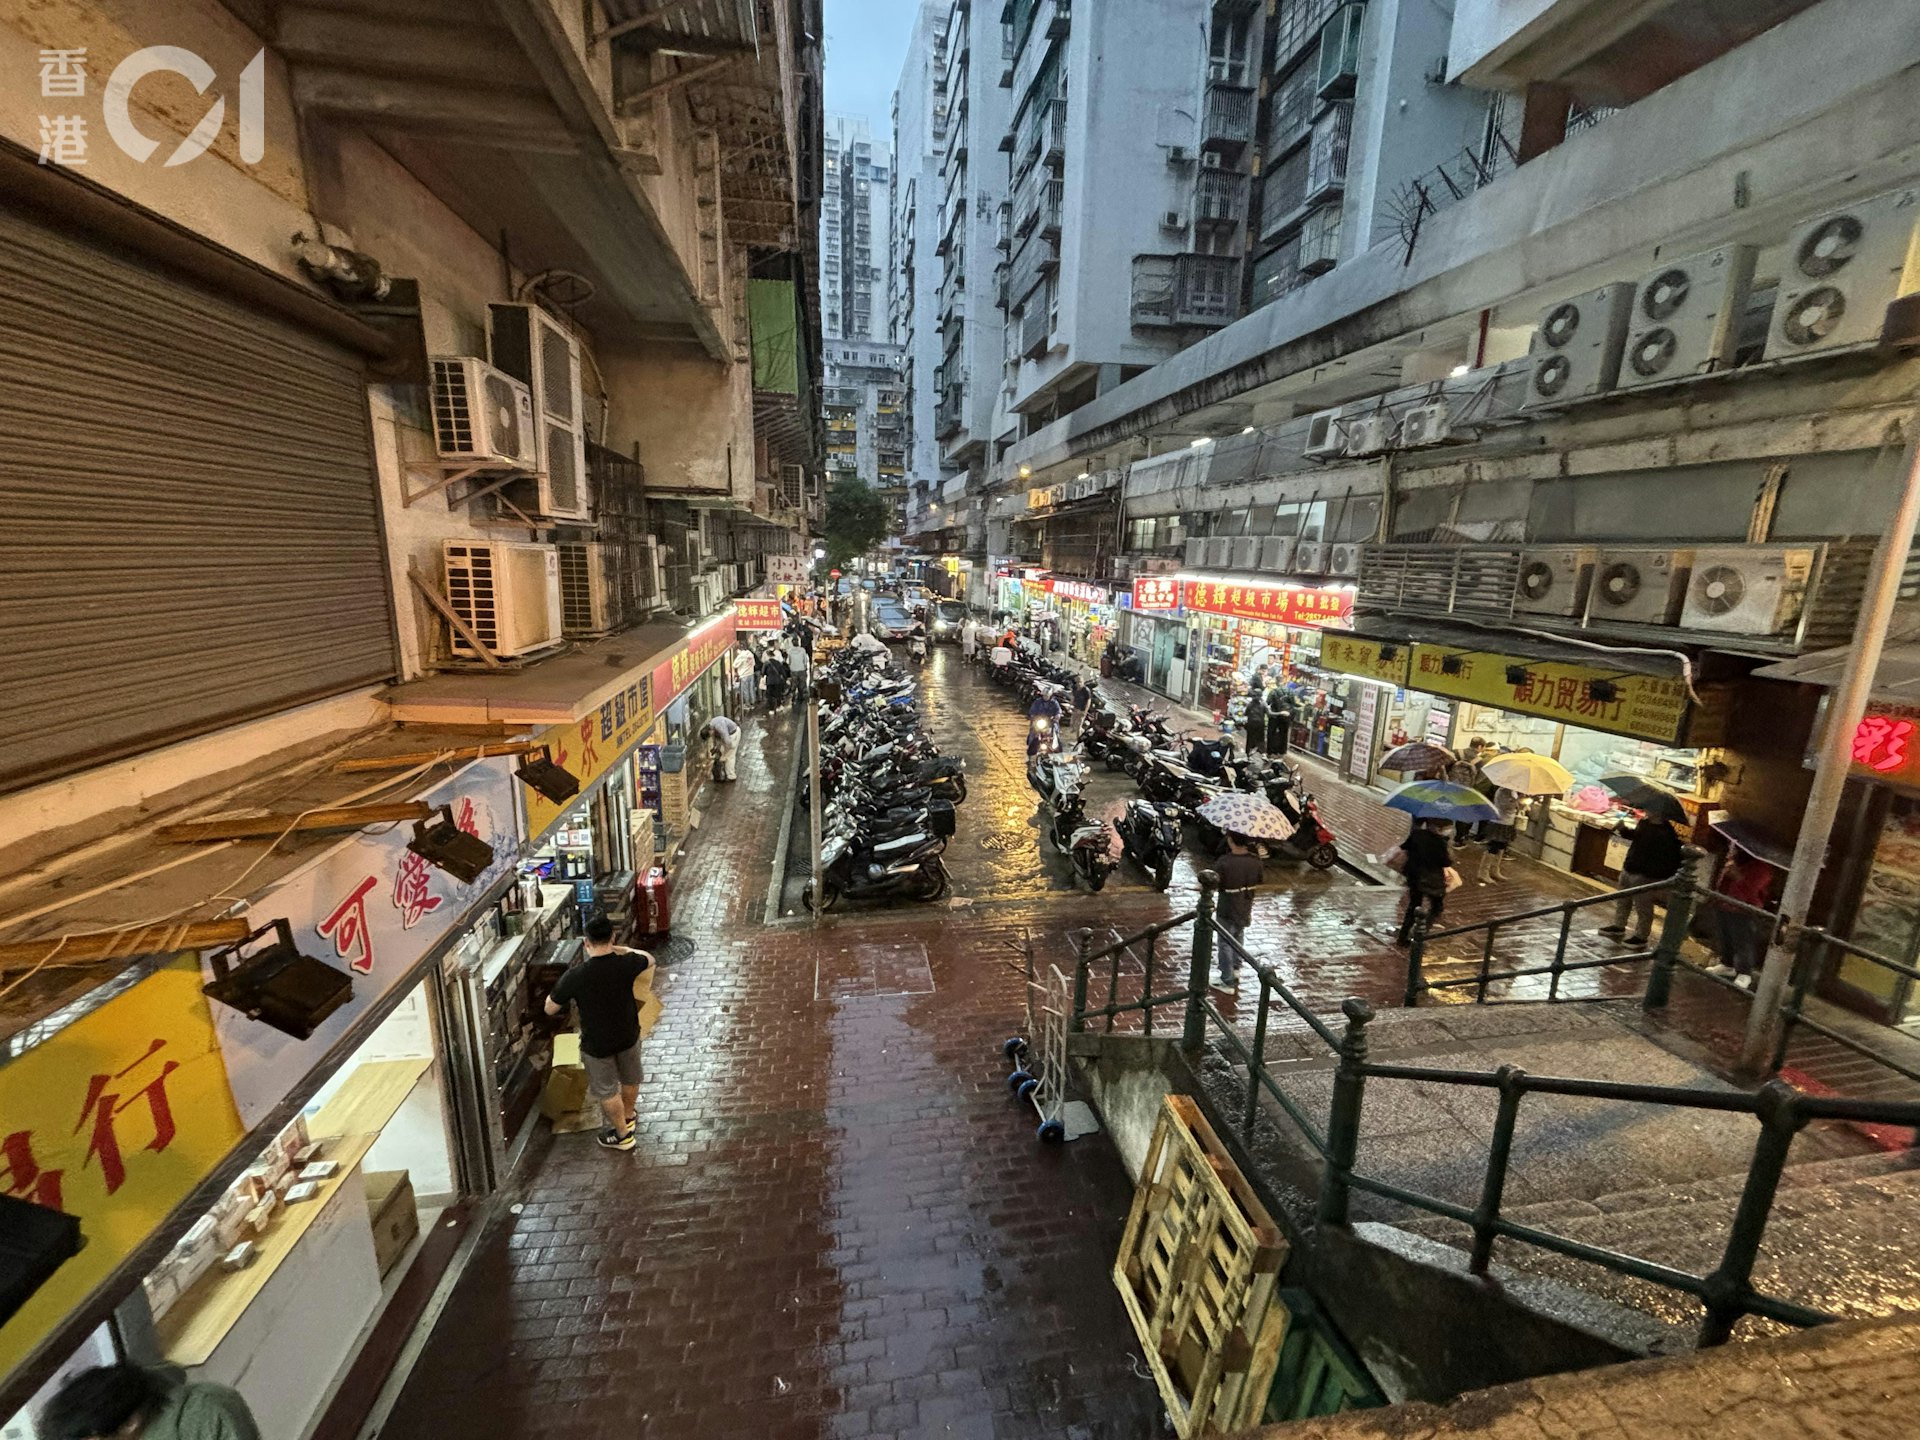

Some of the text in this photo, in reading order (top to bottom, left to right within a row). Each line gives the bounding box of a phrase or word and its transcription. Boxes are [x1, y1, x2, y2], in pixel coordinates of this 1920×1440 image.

[772, 558, 803, 570] 小小
[1194, 582, 1289, 612] 德輝超級市場
[737, 604, 779, 618] 德輝超市
[1853, 717, 1913, 770] 彩
